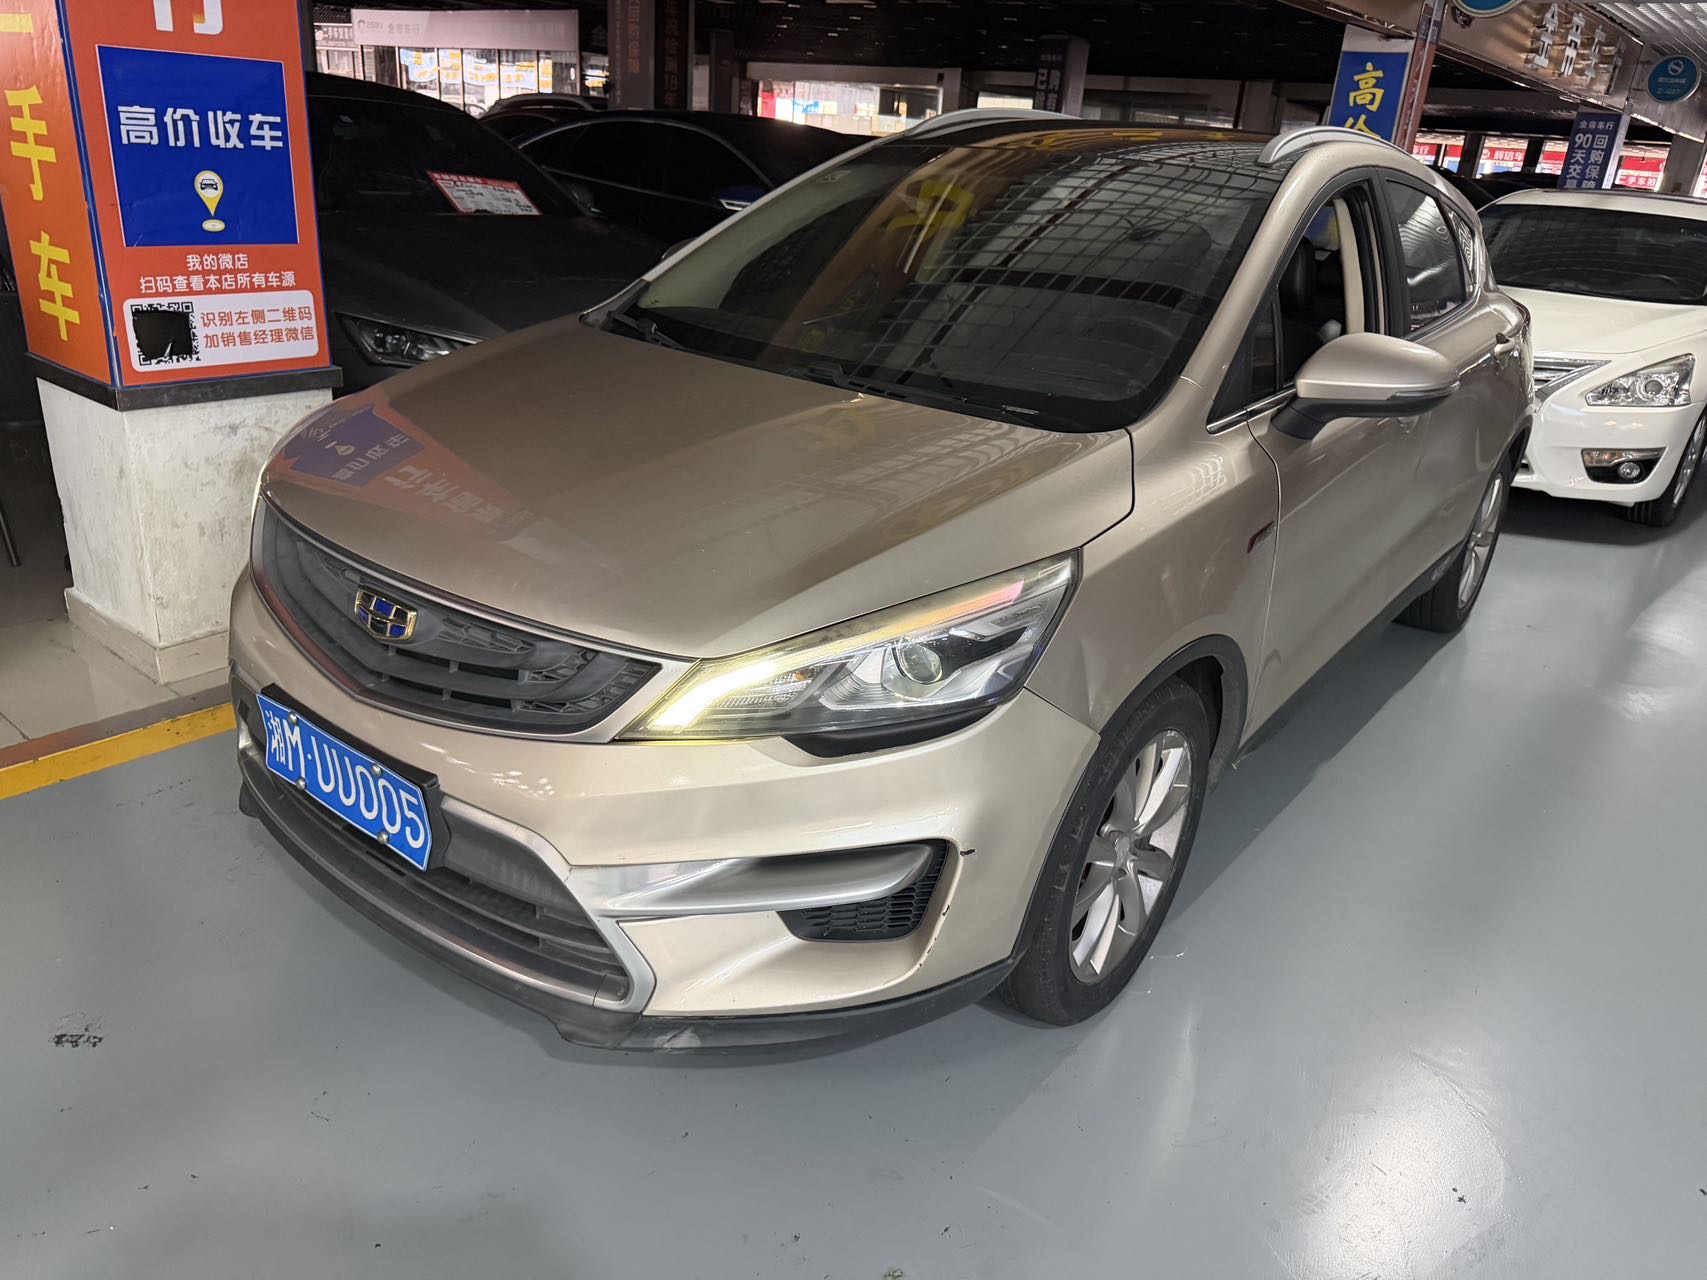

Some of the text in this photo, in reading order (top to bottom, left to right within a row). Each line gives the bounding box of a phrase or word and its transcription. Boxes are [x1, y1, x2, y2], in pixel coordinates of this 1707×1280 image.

[117, 105, 284, 151] 高价收车
[186, 253, 248, 271] 我的微店
[139, 271, 296, 294] 扫码查看本店所有车源
[200, 306, 312, 327] 识别左侧二维码
[204, 326, 315, 348] 加销售经理微信
[265, 710, 425, 849] 湘M·UU005
